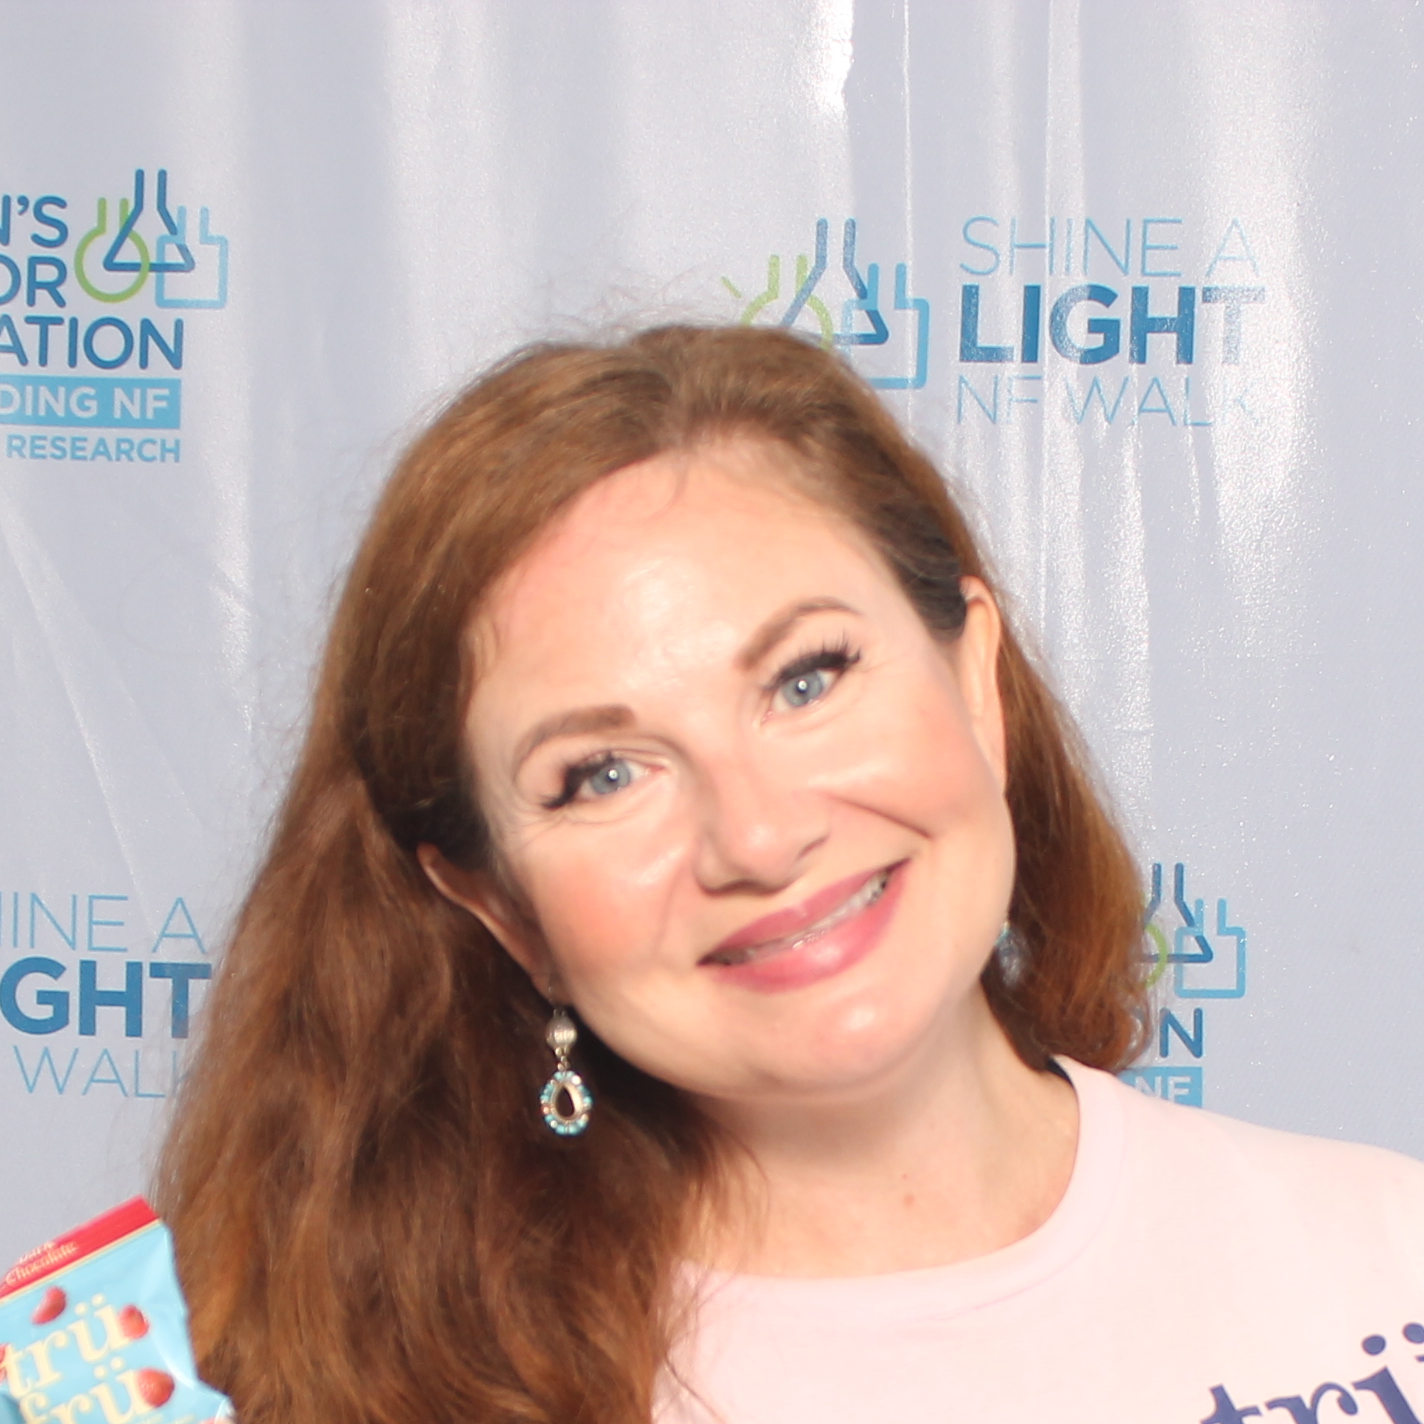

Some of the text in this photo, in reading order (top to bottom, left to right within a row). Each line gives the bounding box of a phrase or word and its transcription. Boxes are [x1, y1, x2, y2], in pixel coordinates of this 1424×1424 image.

[959, 216, 1260, 277] SHINE A
[959, 284, 1265, 365] LIGHT
[113, 388, 170, 420] NF
[957, 374, 1042, 425] NF
[7, 433, 181, 463] RESEARCH
[152, 897, 207, 954] A
